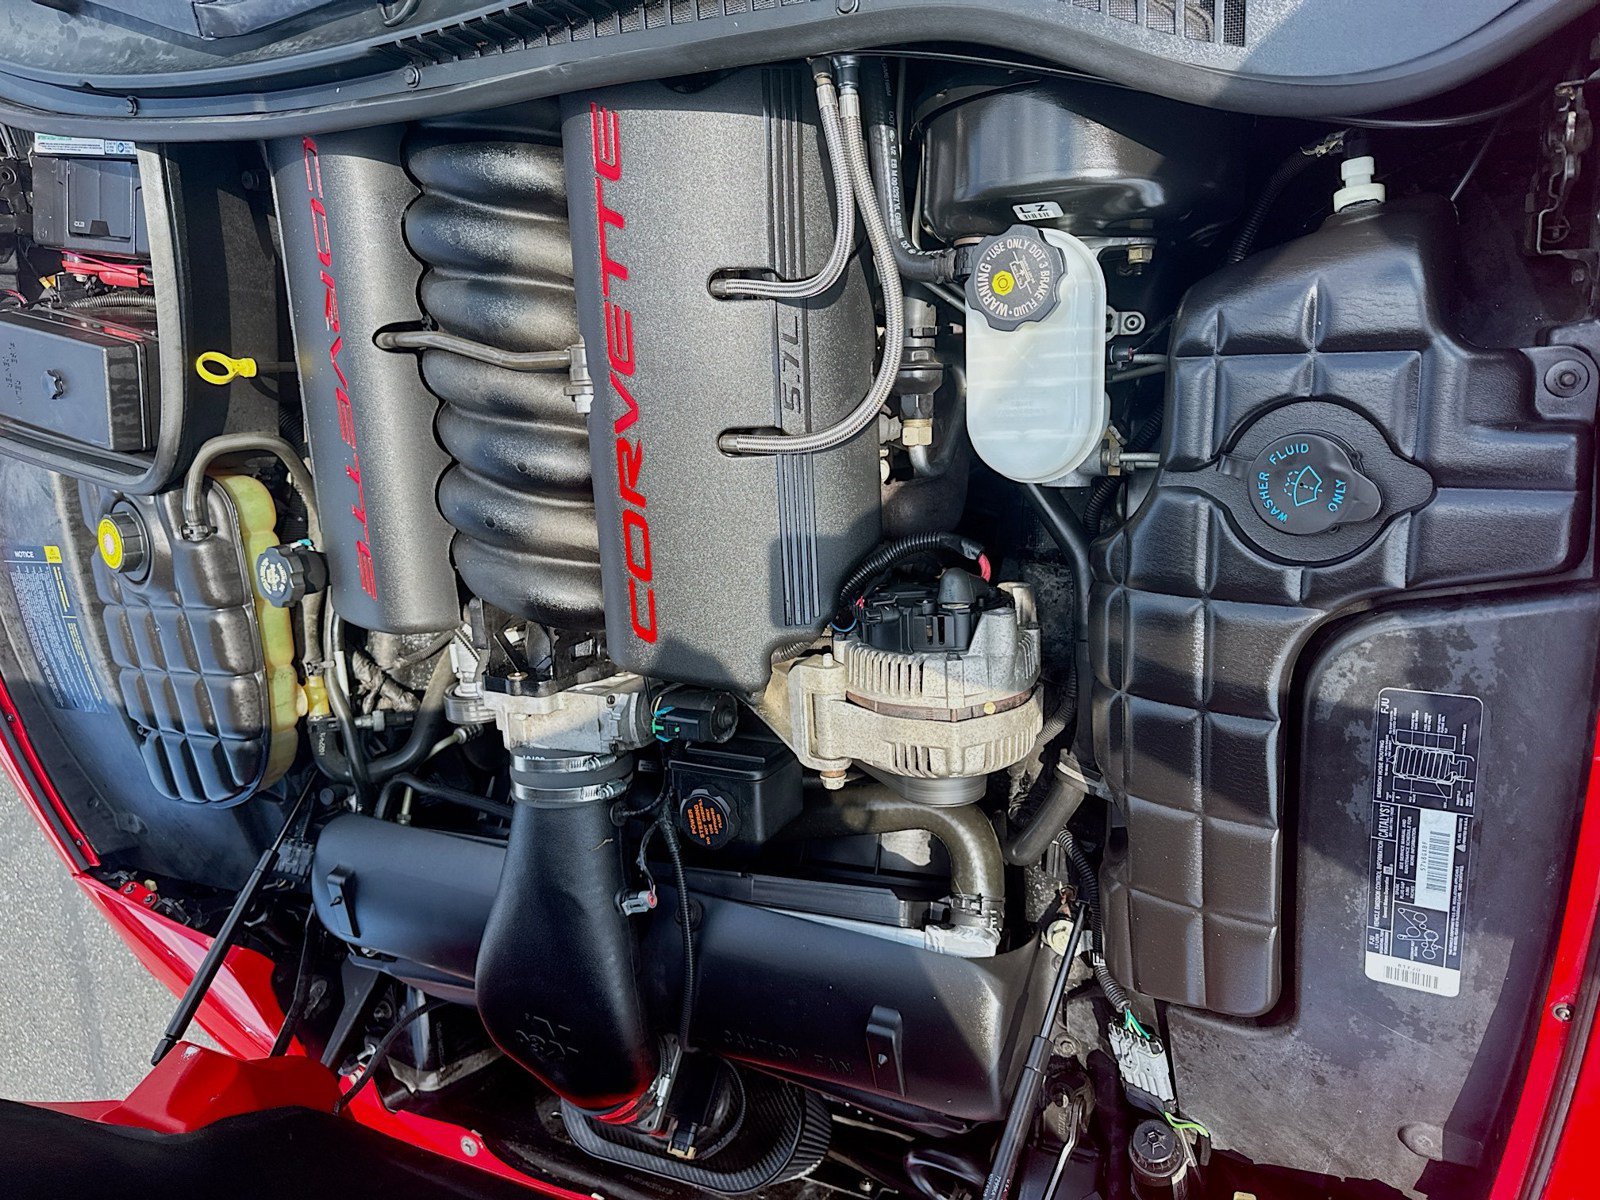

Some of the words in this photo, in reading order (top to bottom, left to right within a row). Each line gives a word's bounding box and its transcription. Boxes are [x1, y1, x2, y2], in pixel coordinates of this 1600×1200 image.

[988, 241, 1008, 259] USE
[1006, 238, 1030, 250] ONLY
[1028, 243, 1046, 261] DOT
[1039, 261, 1049, 269] 3
[977, 262, 1008, 317] WARNING
[1034, 270, 1050, 301] BRAKE
[1013, 298, 1038, 317] FLUID
[303, 136, 378, 600] CORVETTE
[590, 102, 657, 644] CORVETTE
[780, 316, 800, 414] 5.7L
[1269, 443, 1309, 465] FLUID
[1258, 471, 1288, 522] WASHER
[1327, 479, 1346, 512] ONLY
[14, 550, 35, 558] NOTICE
[1380, 697, 1390, 714] FJU
[688, 809, 697, 834] POWER
[694, 804, 705, 838] STEERING
[1378, 803, 1390, 838] CATALYST
